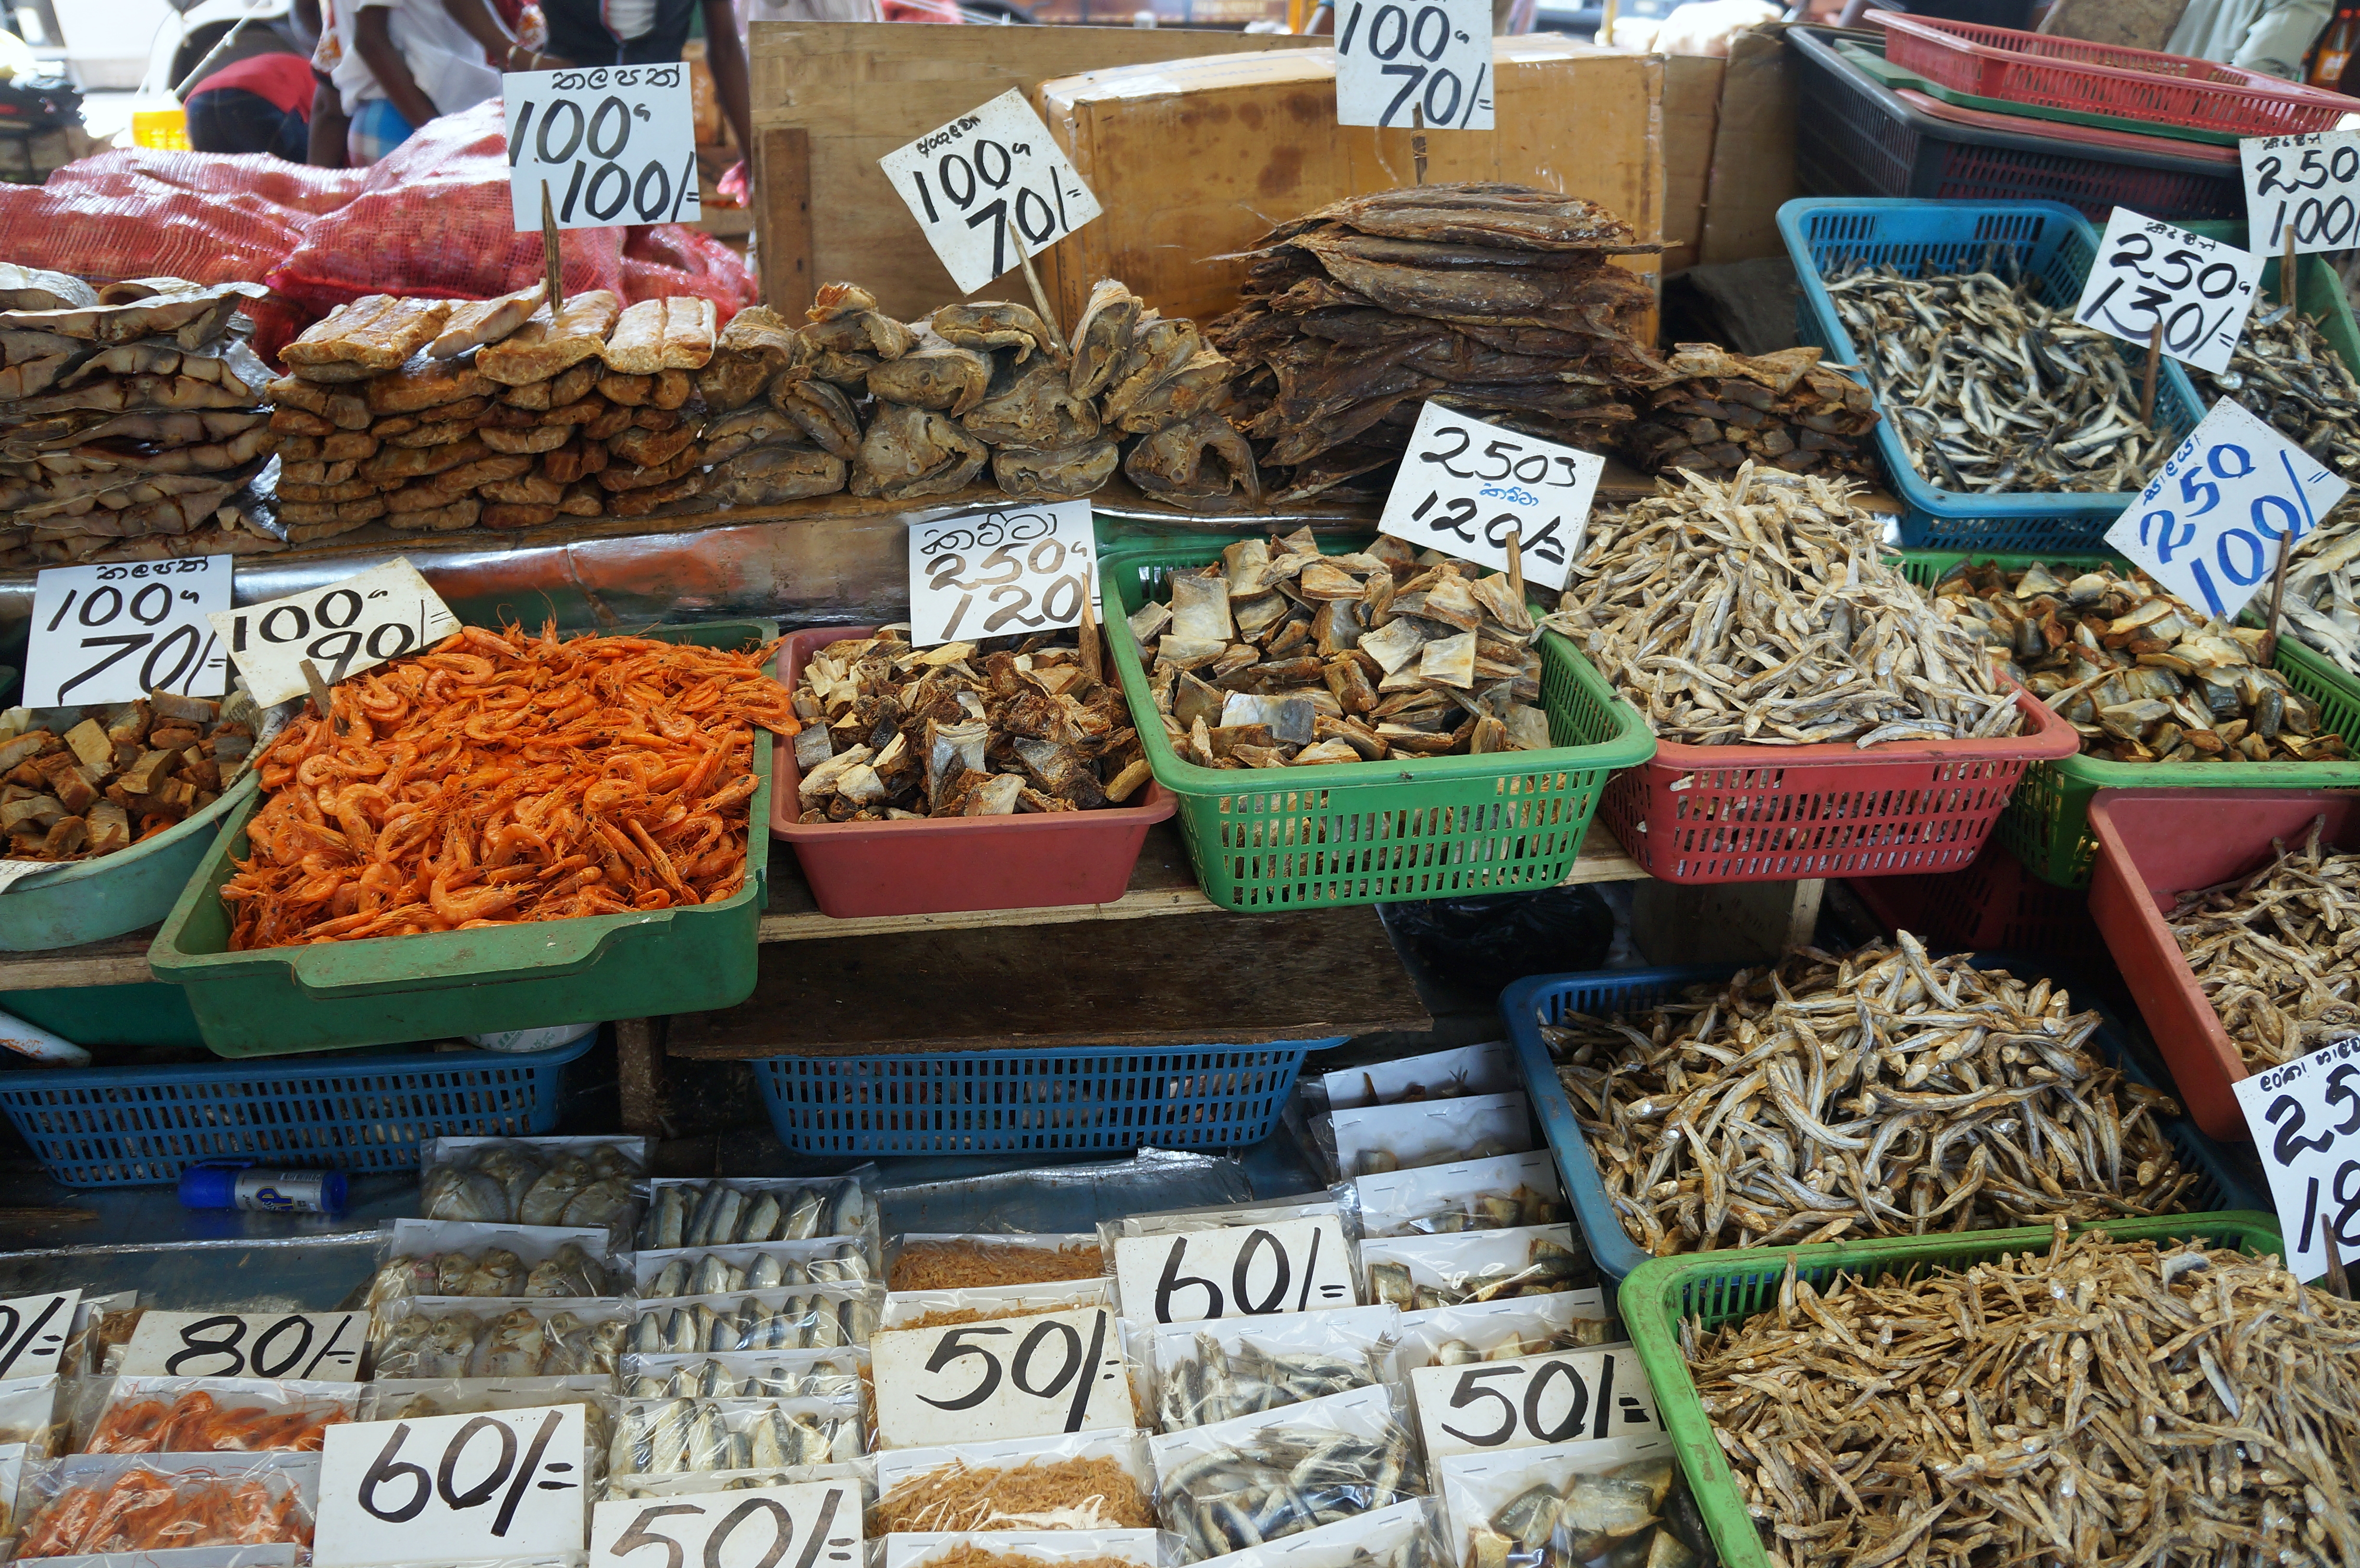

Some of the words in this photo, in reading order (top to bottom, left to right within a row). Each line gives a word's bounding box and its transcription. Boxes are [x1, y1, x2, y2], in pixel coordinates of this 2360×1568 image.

[1378, 62, 1494, 130] 70/=
[560, 151, 699, 223] 100/=
[965, 166, 1082, 280] 70/=
[2080, 276, 2235, 360] 130/=
[2139, 443, 2257, 565] 250
[2189, 449, 2330, 616] 100/=
[57, 624, 227, 707] 70/=
[1154, 1227, 1346, 1324] 60/=
[165, 1314, 356, 1380] 80/=
[915, 1309, 1120, 1434] 50/=
[1441, 1354, 1651, 1446] 50/=
[358, 1409, 578, 1537] 60/=
